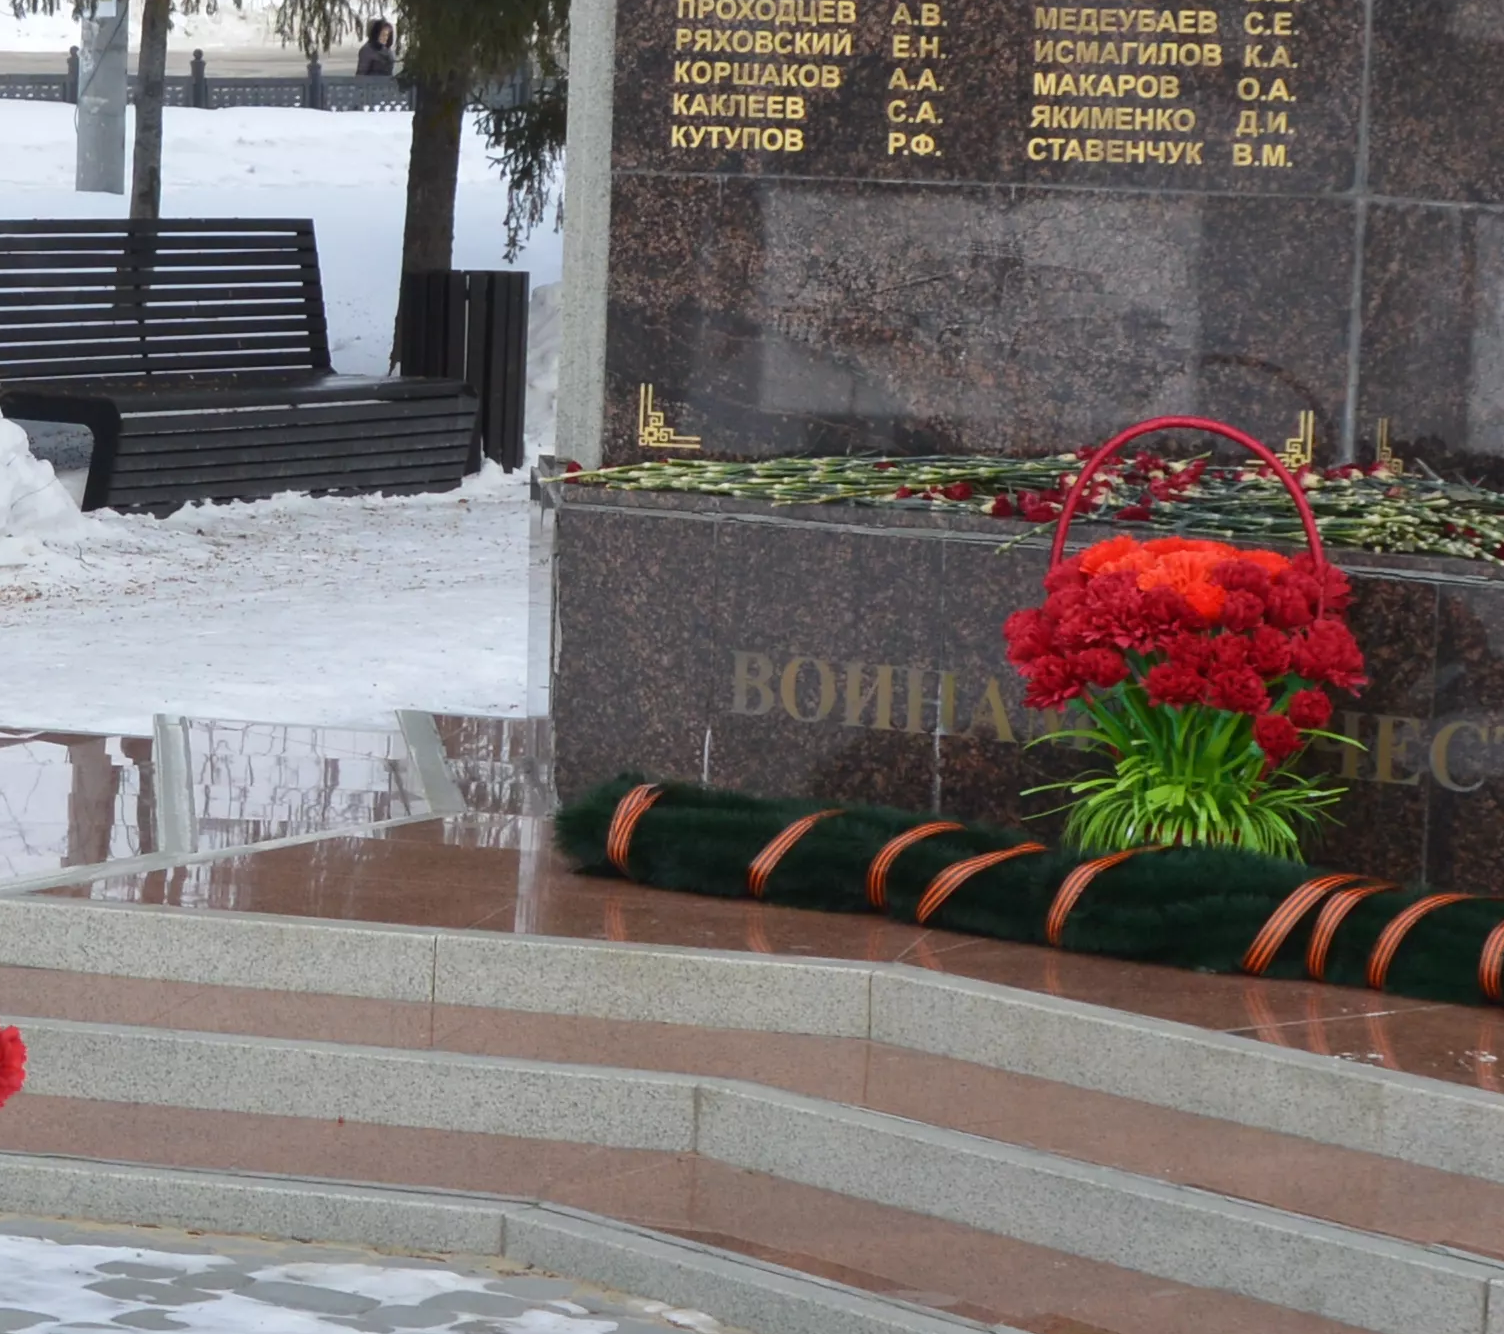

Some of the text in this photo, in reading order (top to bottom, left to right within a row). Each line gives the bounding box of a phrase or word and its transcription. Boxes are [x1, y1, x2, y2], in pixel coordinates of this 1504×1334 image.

[890, 2, 949, 27] А.В.
[1034, 7, 1299, 36] МЕДЕУБАЕВ С.Е.
[675, 27, 948, 60] РЯХОВСКИЙ Е.Н.
[1034, 39, 1299, 69] ИСМАГИЛОВ К.А.
[673, 60, 945, 92] КОРШАКОВ А.А.
[1033, 72, 1297, 102] МАКАРОВ О.А.
[672, 92, 944, 124] КАКЛЕЕВ С.А.
[1029, 104, 1296, 138] ЯКИМЕНКО Д.И.
[671, 124, 943, 157] КУТУПОВ Р.Ф.
[1027, 137, 1293, 168] СТАВЕНЧУК В.М.
